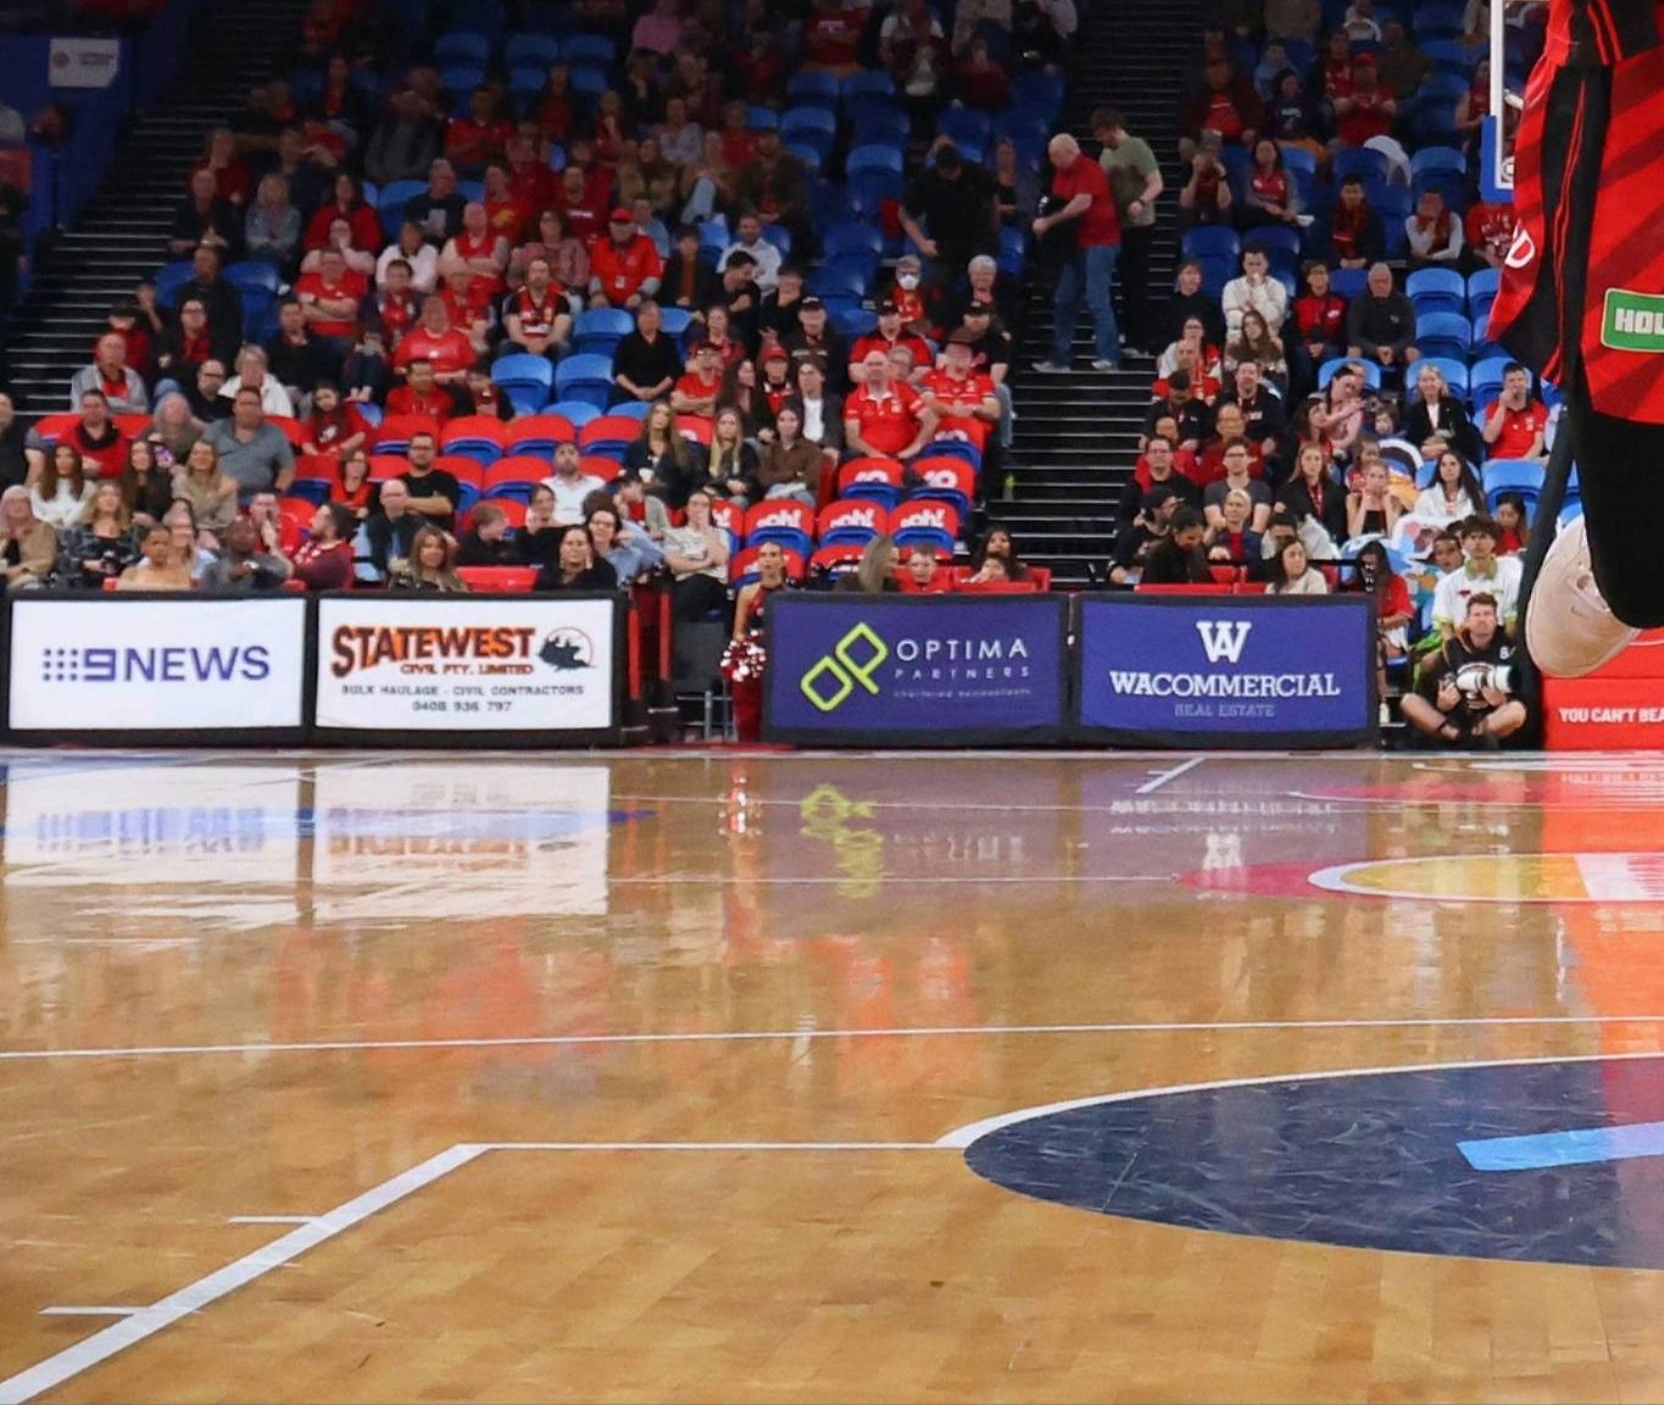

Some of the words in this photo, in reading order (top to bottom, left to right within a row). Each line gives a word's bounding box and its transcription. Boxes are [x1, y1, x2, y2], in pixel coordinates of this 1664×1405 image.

[331, 625, 536, 678] STATEWEST
[897, 638, 1028, 661] OPTIMA
[400, 664, 437, 675] CIVIL
[479, 664, 534, 675] LIMITED
[895, 666, 1029, 679] PARTNERS
[342, 685, 374, 695] BULK
[381, 685, 439, 695] HAULAGE
[453, 685, 486, 695] CIVIL
[491, 685, 584, 696] CONTRACTORS
[1109, 670, 1341, 697] WACOMMERCIAL
[1174, 704, 1213, 717] REAL
[1218, 704, 1275, 717] ESTATE
[1559, 707, 1589, 723] YOU
[1591, 707, 1637, 723] CAN'T
